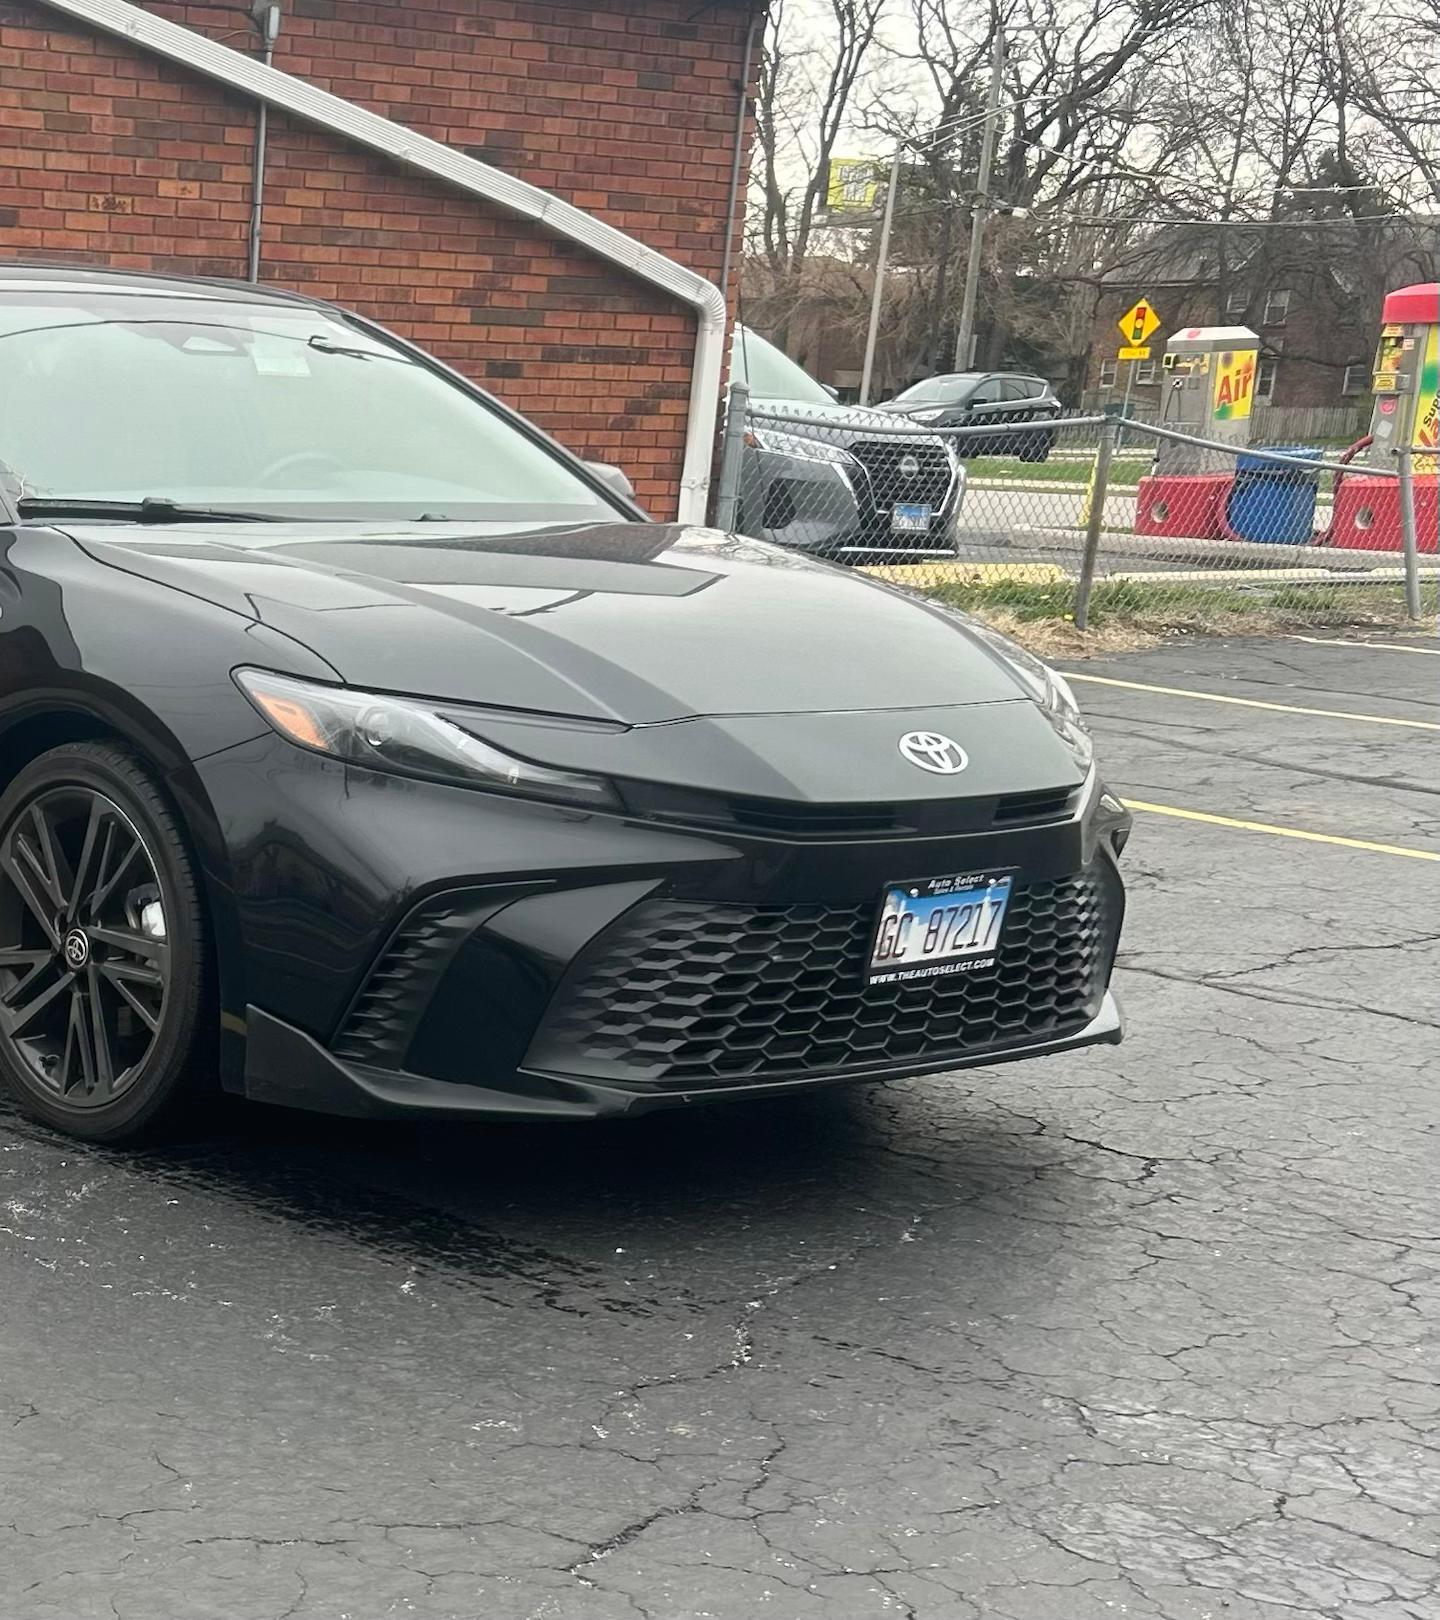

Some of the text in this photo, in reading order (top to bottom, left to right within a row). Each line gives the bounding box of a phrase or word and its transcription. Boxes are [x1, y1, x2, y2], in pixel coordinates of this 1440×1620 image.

[1216, 369, 1253, 408] Air
[927, 879, 952, 889] Auto
[954, 874, 985, 886] Select
[876, 900, 1003, 961] GC 87217
[869, 957, 996, 985] WWW.THEAUTOSELECT.COM
